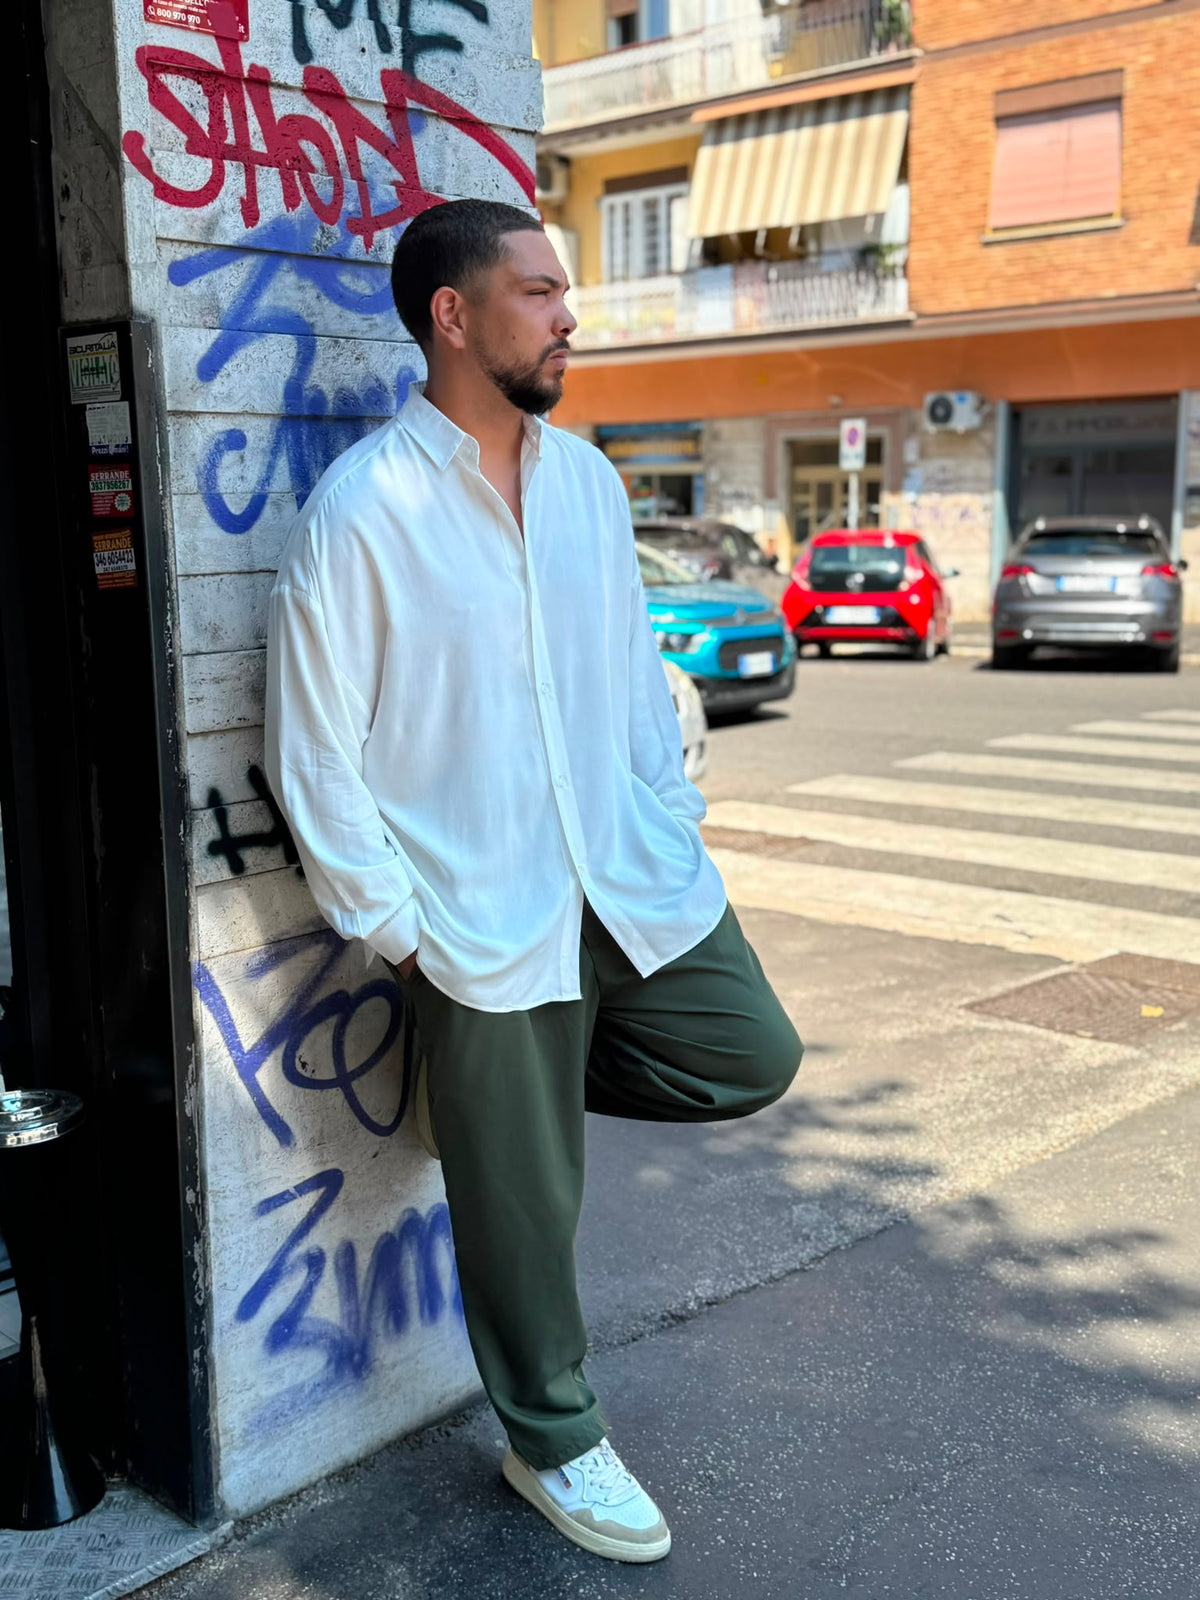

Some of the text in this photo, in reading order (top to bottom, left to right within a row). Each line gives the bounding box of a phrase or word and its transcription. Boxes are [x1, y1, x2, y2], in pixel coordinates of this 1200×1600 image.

[156, 8, 201, 24] 800 970 970
[90, 470, 130, 481] SERRANDE
[94, 537, 132, 552] SERRANDE
